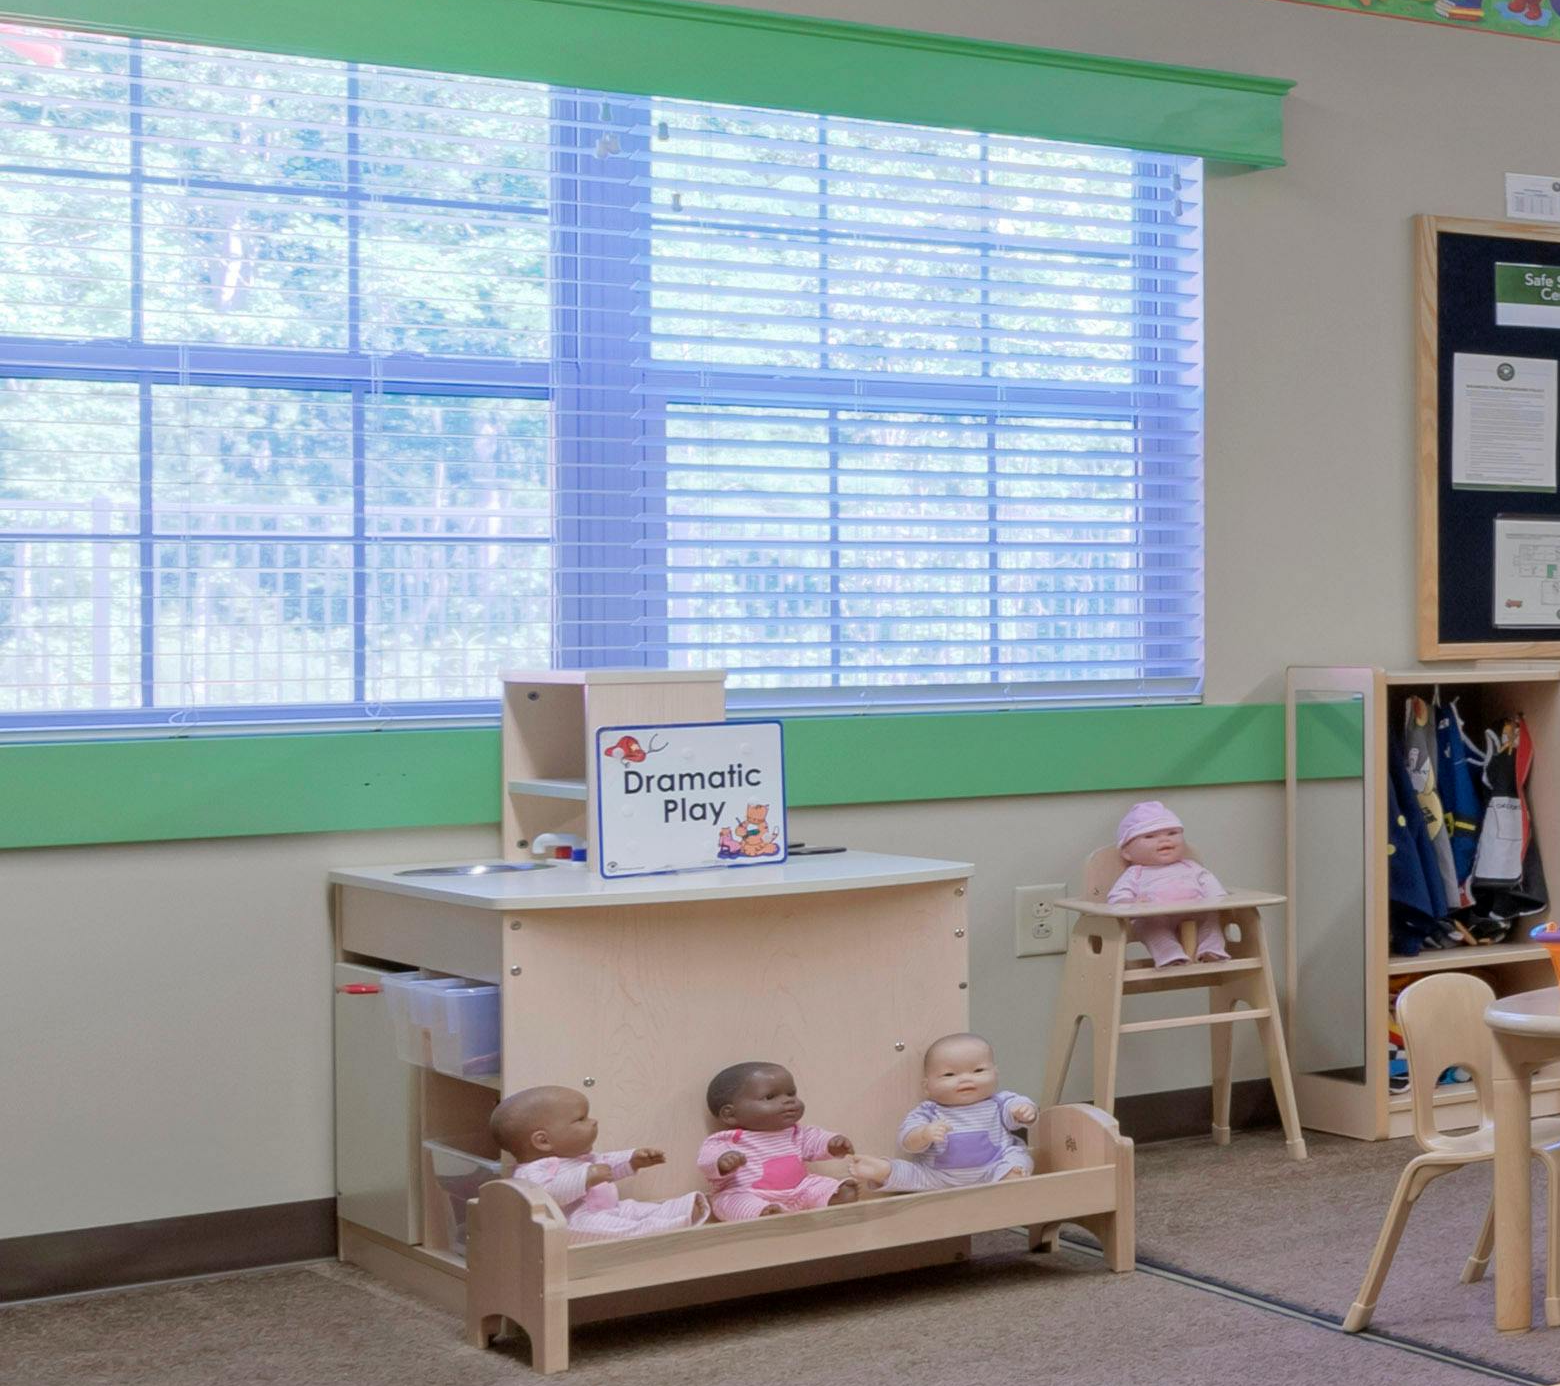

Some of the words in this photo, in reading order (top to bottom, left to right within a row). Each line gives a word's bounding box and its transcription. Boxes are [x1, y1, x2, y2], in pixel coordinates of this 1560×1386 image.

[1525, 273, 1554, 287] Safe
[624, 763, 761, 795] Dramatic
[664, 798, 726, 826] Play
